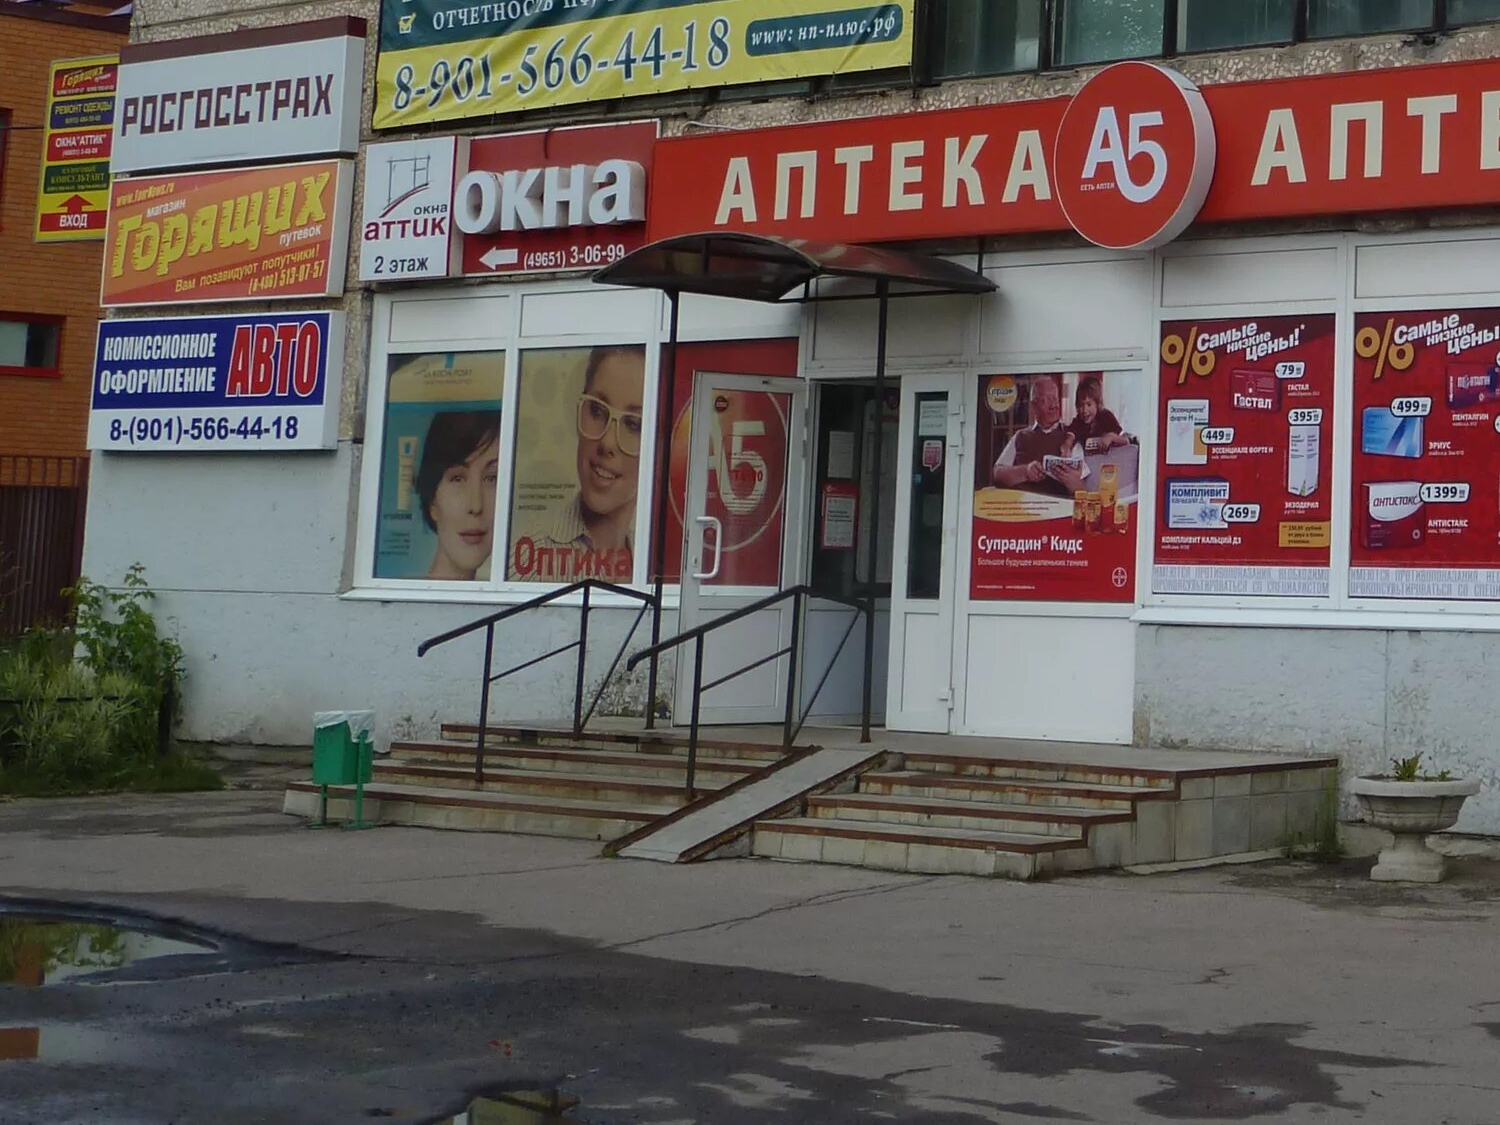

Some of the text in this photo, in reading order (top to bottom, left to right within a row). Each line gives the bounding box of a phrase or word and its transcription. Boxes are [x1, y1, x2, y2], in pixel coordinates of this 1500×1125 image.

[393, 17, 731, 112] 8-901-566-44-18
[798, 11, 896, 42] нп-плюс.рф
[55, 101, 113, 115] РЕМОНТ ОДЕЖДЫ
[121, 74, 334, 137] РОСГОССТРАХ
[714, 128, 1052, 225] АПТЕКА
[147, 198, 187, 218] магазин
[60, 213, 88, 229] ВХОД
[111, 172, 330, 278] Горящих
[279, 225, 322, 247] путевок
[374, 255, 429, 274] 2 этаж
[523, 244, 625, 271] (49651) 3-06-99
[175, 244, 320, 293] Вам позавидуют попутчики!
[1196, 322, 1258, 352] Самые
[1394, 313, 1460, 345] Самые
[1426, 323, 1475, 346] низкие
[103, 333, 217, 362] КОМИССИОННОЕ
[1227, 332, 1272, 354] низкие
[225, 320, 321, 398] АВТО
[1281, 364, 1295, 375] 79
[100, 367, 216, 394] ОФОРМЛЕНИЕ
[1288, 383, 1310, 391] ГАСТАЛ
[1233, 393, 1273, 409] Гастал
[1396, 400, 1420, 413] 499
[1292, 411, 1313, 422] 395
[1452, 413, 1489, 421] ПЕНТАЛГИН
[110, 416, 299, 445] 8-(901)-566-44-18
[1205, 430, 1225, 441] 449
[1428, 441, 1451, 449] ЭРИУС
[1171, 488, 1227, 497] КОМПЛИВИТ
[1227, 507, 1250, 518] 269
[1428, 519, 1469, 527] АНТИСТАКС
[1051, 536, 1083, 554] Кидс
[514, 536, 632, 577] Оптика
